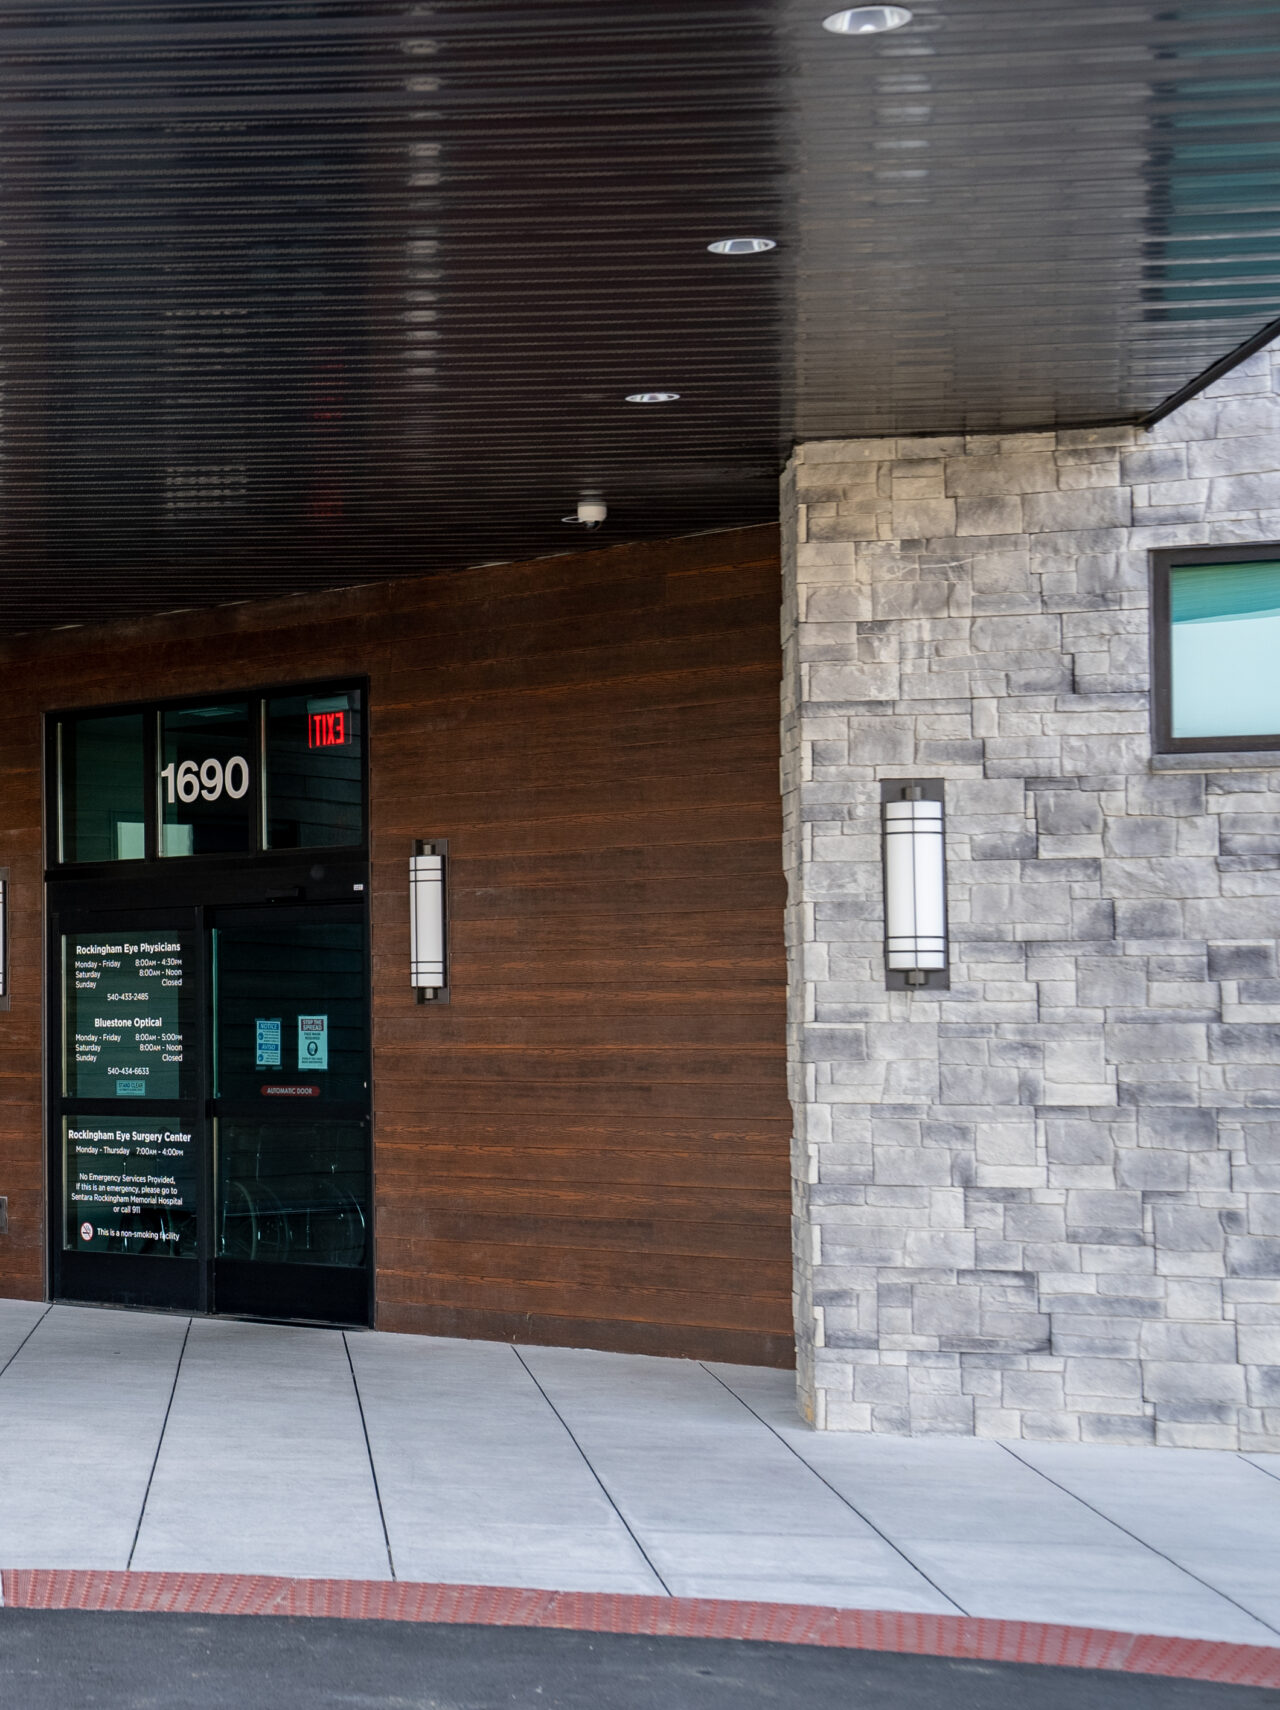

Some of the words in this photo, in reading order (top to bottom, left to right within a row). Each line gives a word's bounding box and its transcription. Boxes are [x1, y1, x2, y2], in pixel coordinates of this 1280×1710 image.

[161, 756, 249, 803] 1690
[76, 944, 122, 955] Rockingham
[124, 944, 138, 954] Eye
[140, 942, 181, 954] Physicians
[75, 961, 98, 969] Monday
[102, 960, 121, 968] Friday
[76, 971, 100, 979] Saturday
[76, 981, 96, 989] Sunday
[95, 1018, 132, 1027] Bluestone
[134, 1017, 162, 1028] Optical
[76, 1034, 98, 1042] Monday
[103, 1034, 121, 1042] Friday
[76, 1044, 101, 1052] Saturday
[76, 1054, 97, 1062] Sunday
[108, 1067, 149, 1075] 540-434-6633
[68, 1130, 114, 1141] Rockingham
[116, 1131, 130, 1141] Eye
[132, 1132, 162, 1143] Surgery
[164, 1133, 191, 1142] Center
[76, 1146, 98, 1154] Monday
[104, 1146, 130, 1155] Thursday
[89, 1173, 120, 1182] Emergency
[122, 1174, 146, 1182] Services
[148, 1176, 176, 1184] Provided,
[107, 1185, 140, 1193] emergency,
[141, 1186, 160, 1194] please
[94, 1194, 129, 1203] Rockingham
[130, 1196, 157, 1204] Memorial
[158, 1197, 182, 1206] Hospital
[132, 1206, 140, 1214] 911
[110, 1228, 115, 1236] is
[121, 1229, 158, 1240] non-smoking
[160, 1232, 180, 1241] facility
